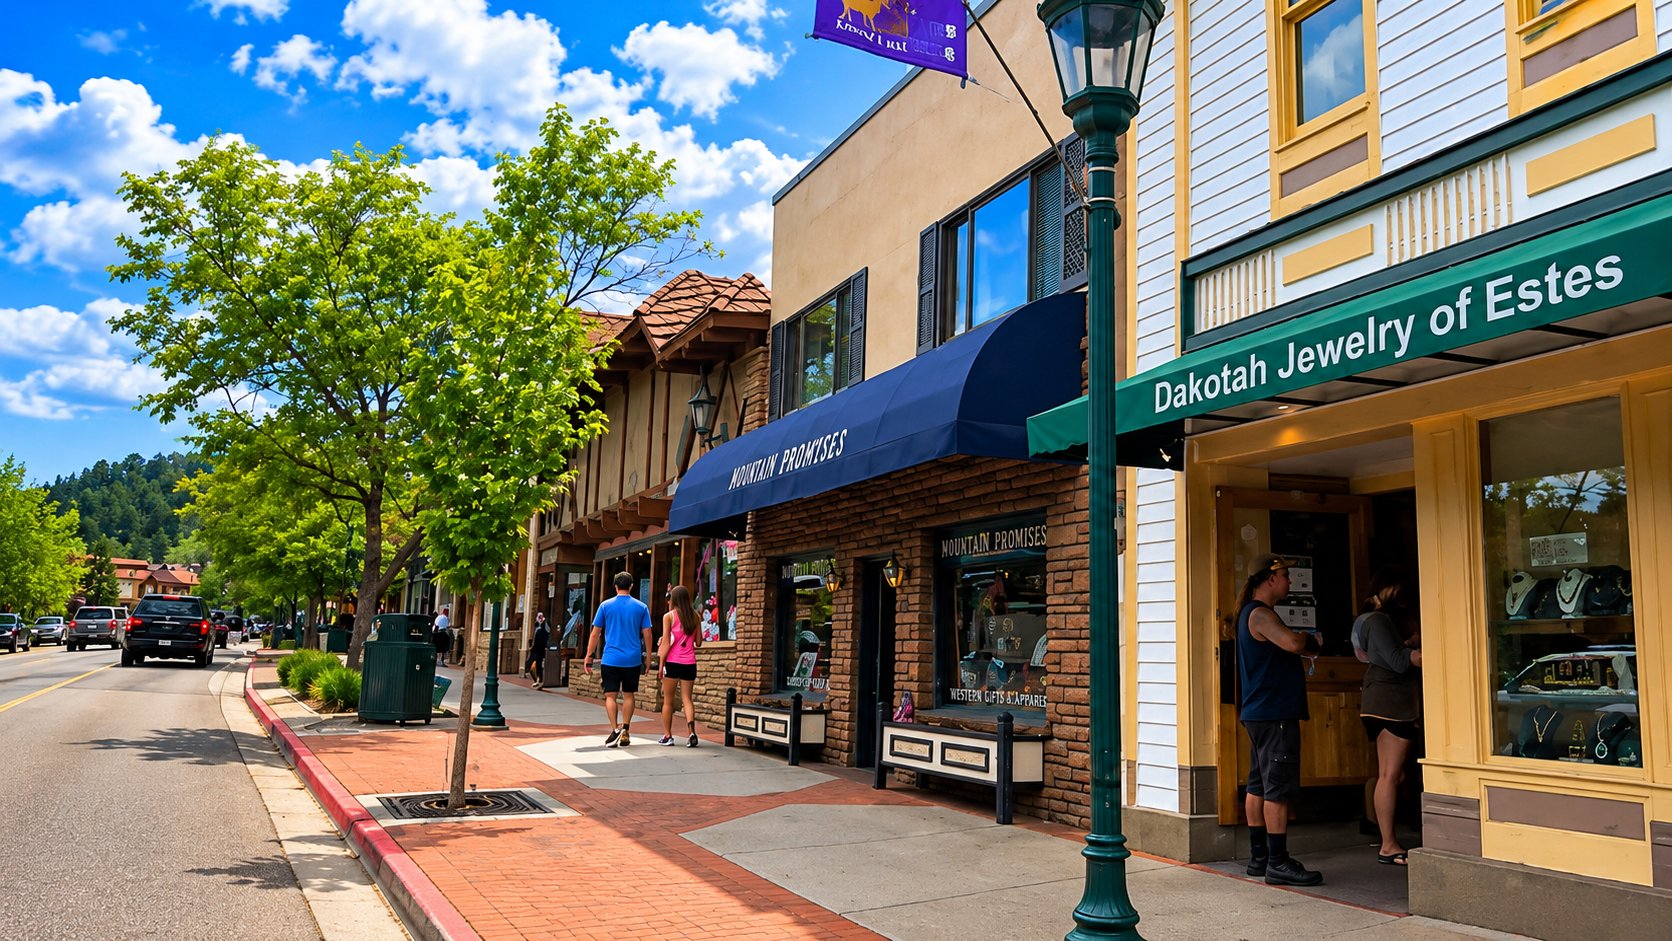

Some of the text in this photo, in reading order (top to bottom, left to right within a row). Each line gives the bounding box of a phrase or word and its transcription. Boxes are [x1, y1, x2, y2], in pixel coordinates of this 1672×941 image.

[1155, 255, 1624, 414] Dakotah Jewelry of Estes
[728, 453, 779, 490] MOUNTAIN
[994, 524, 1047, 550] PROMISES
[984, 690, 1005, 704] GIFTS
